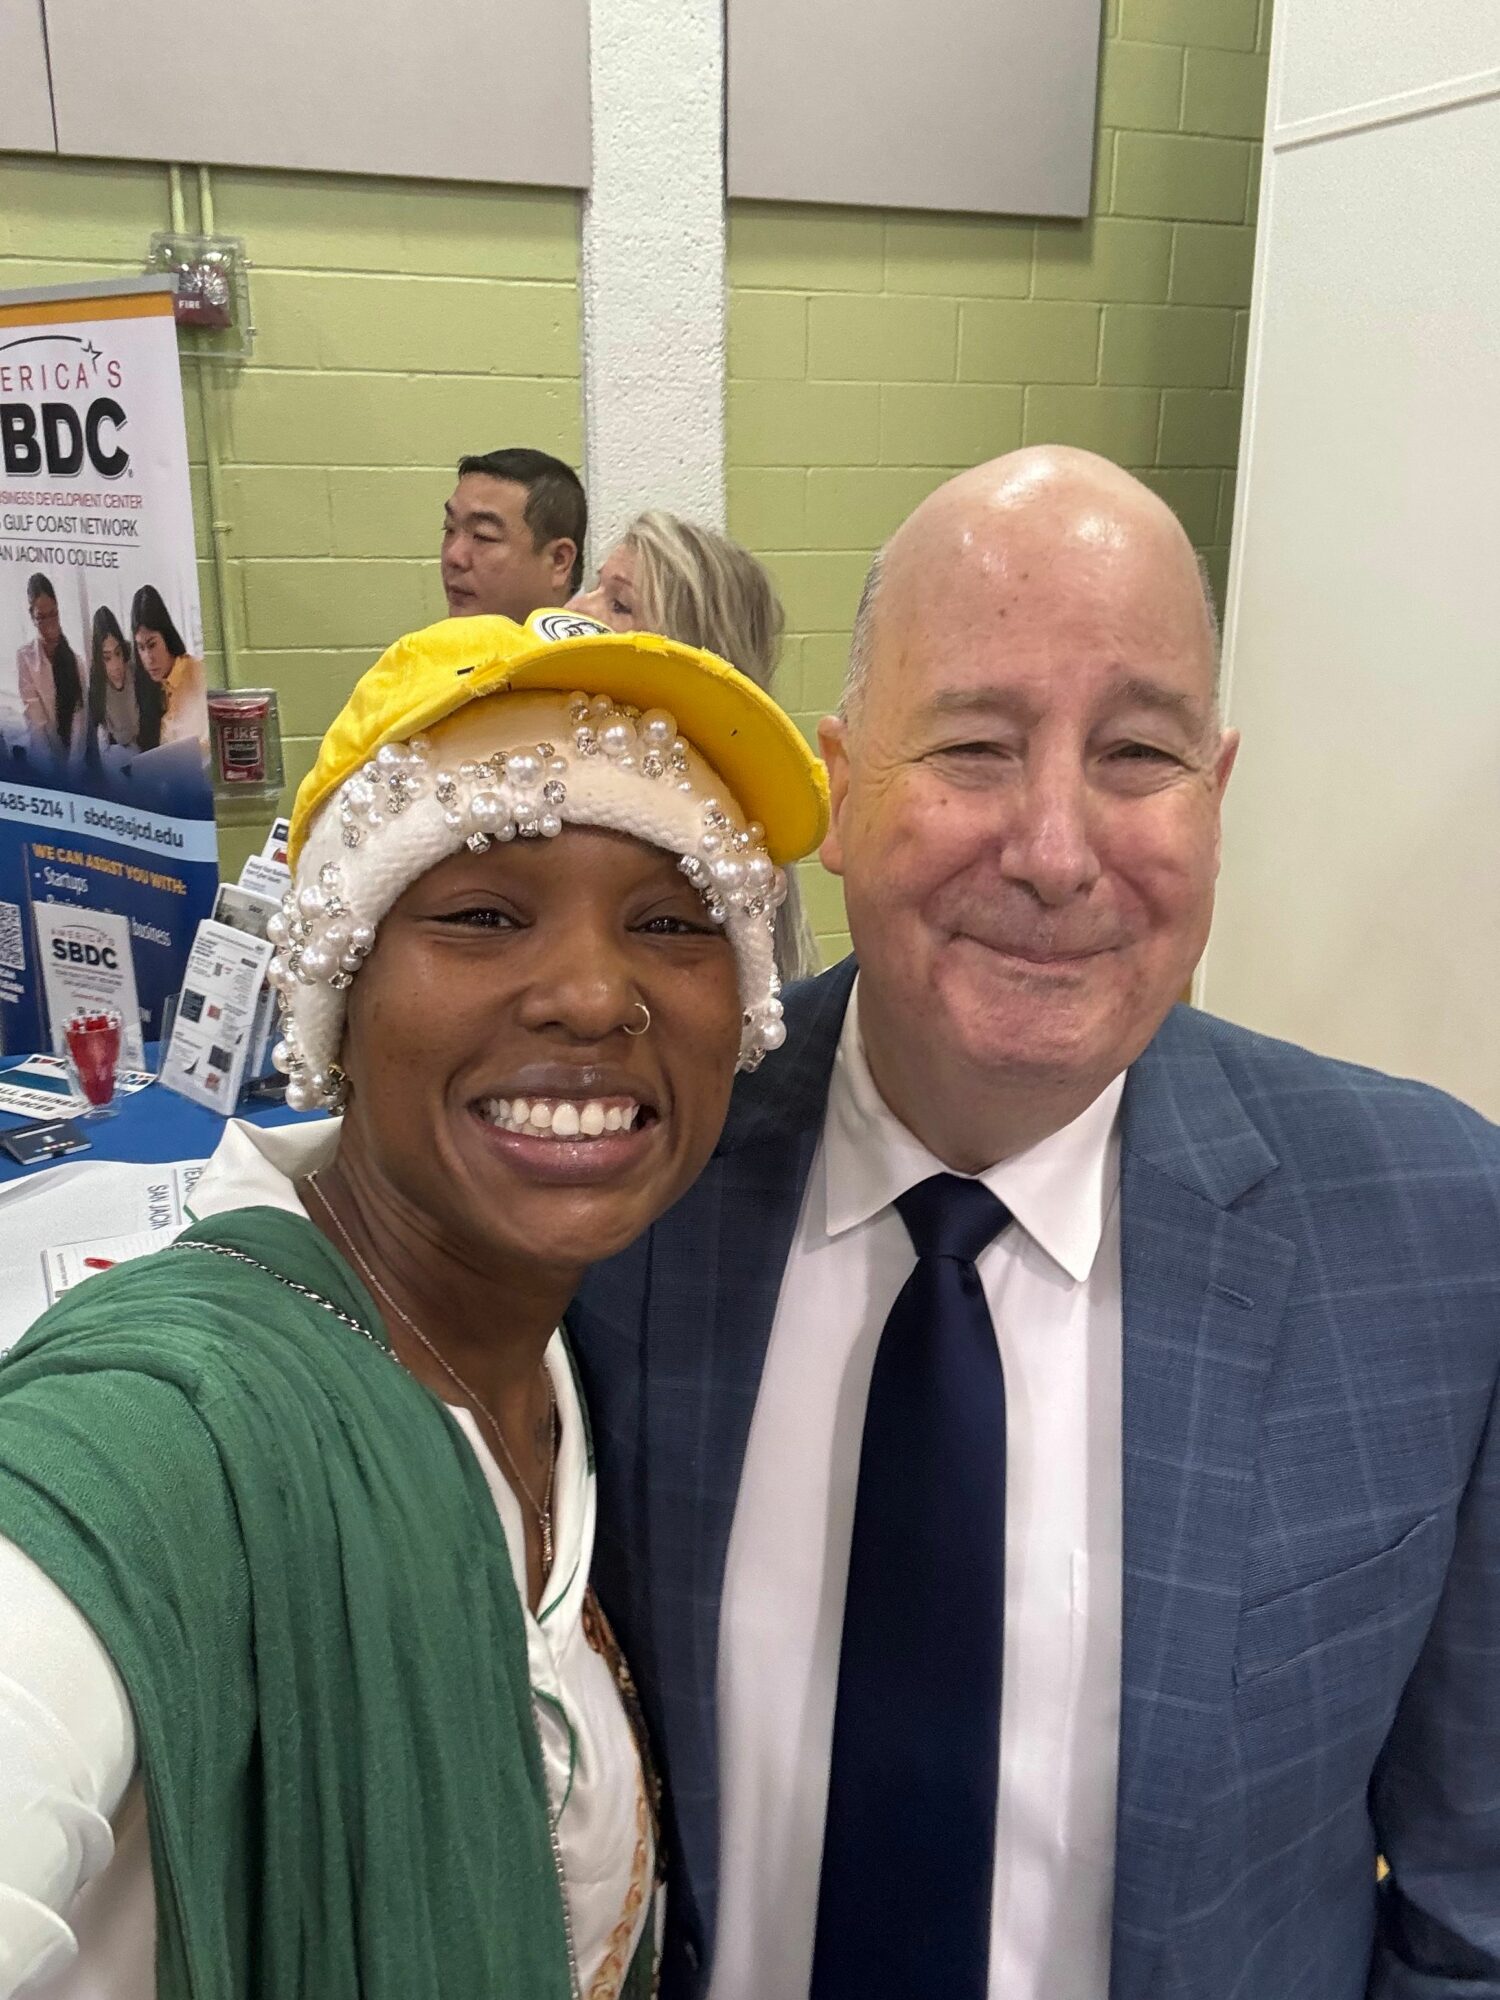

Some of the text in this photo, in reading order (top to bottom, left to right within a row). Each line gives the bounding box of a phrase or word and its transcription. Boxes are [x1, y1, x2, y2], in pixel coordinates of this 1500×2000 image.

[179, 300, 201, 309] FIRE
[0, 491, 143, 509] SINESS DEVELOPMENT CENTER
[4, 514, 139, 536] GULF COAST NETWORK
[16, 546, 65, 564] JACINTO
[68, 549, 120, 568] COLLEGE
[223, 727, 259, 739] FIRE
[0, 792, 184, 848] 485-5214 sbdc@sjcd.edu
[32, 843, 55, 860] WE
[56, 848, 84, 866] CAN
[85, 854, 123, 877] ASSIST
[125, 864, 149, 884] YOU
[43, 866, 89, 896] Startups
[52, 938, 118, 970] SBDC
[147, 1184, 170, 1203] SAN
